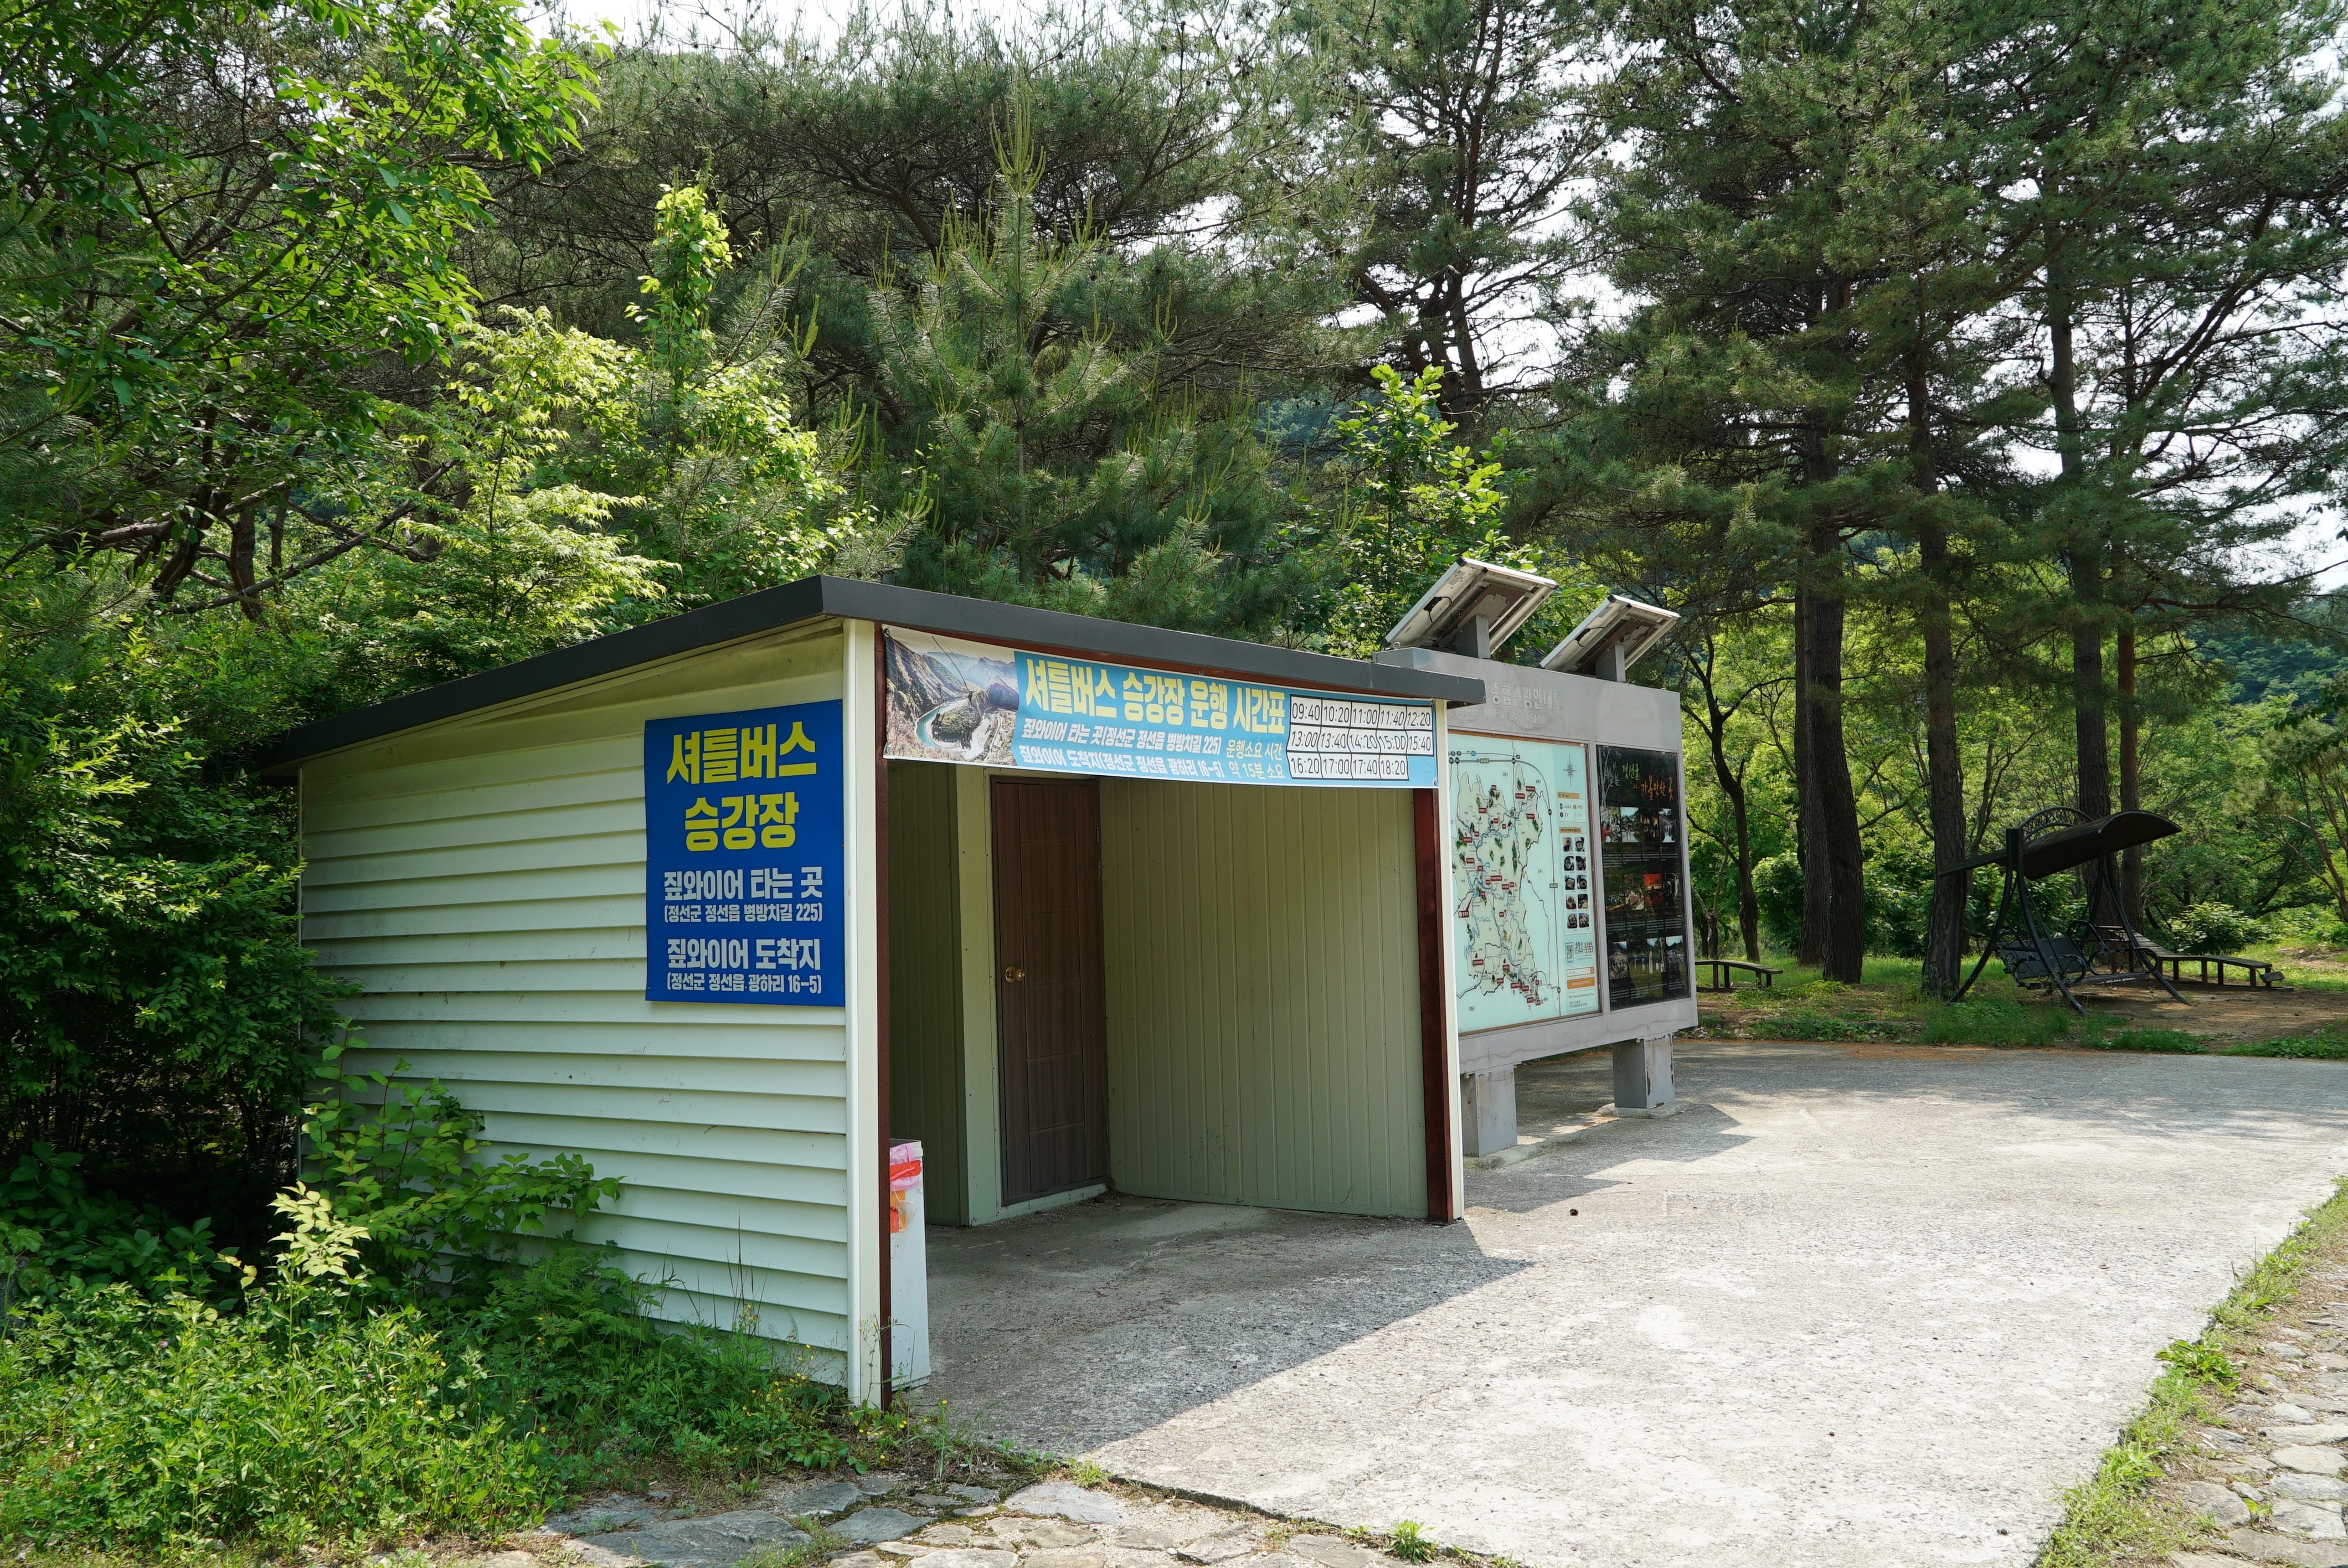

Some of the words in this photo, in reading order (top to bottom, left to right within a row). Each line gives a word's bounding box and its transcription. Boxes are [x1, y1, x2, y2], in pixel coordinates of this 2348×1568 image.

[1025, 658, 1117, 718] 셔틀버스
[1123, 672, 1185, 725] 승강장
[1190, 680, 1228, 729] 운행
[1233, 687, 1285, 734] 시간표
[1491, 681, 1563, 711] 종합관광안내도
[1292, 703, 1320, 721] 09:40
[1324, 705, 1350, 723] 10:20
[1353, 708, 1378, 725] 11:00
[1381, 710, 1404, 726] 11:40
[1408, 712, 1430, 726] 12:20
[1021, 718, 1068, 742] 짚와이어
[1067, 724, 1090, 744] 타는
[1136, 730, 1165, 750] 정선읍
[1166, 733, 1202, 754] 병방치길
[1202, 735, 1222, 755] 225)
[1291, 731, 1317, 747] 13:00
[1321, 733, 1346, 749] 13:40
[1350, 735, 1378, 749] 14:20
[1378, 735, 1406, 750] 15:00
[1409, 736, 1431, 751] 15:40
[667, 721, 816, 785] 셔틀버스
[1018, 745, 1068, 767] 짚와이어
[1136, 756, 1168, 775] 정선읍
[1167, 758, 1199, 776] 광하리
[1197, 760, 1225, 778] 16-5)
[1226, 739, 1263, 759] 운행소요
[1264, 742, 1283, 761] 시간
[1228, 761, 1242, 778] 약
[1242, 762, 1266, 780] 15분
[1266, 764, 1286, 779] 소요
[1291, 757, 1320, 774] 16:20
[1323, 759, 1349, 775] 17:00
[1353, 759, 1378, 775] 17:40
[1381, 760, 1405, 775] 18:20
[1622, 762, 1639, 781] 정선군
[685, 792, 799, 852] 승강장
[664, 869, 743, 901] 짚와이어
[750, 868, 793, 899] 타는
[800, 866, 823, 898] 곳
[665, 905, 702, 923] (정선군
[705, 904, 740, 922] 정선읍
[744, 903, 793, 922] 병방치길
[796, 902, 823, 922] 225)
[667, 938, 749, 969] 짚와이어
[755, 937, 821, 970] 도착지
[667, 972, 705, 991] (정선군
[708, 973, 745, 992] 정선읍
[748, 973, 785, 993] 광하리
[787, 974, 822, 994] 16-5)
